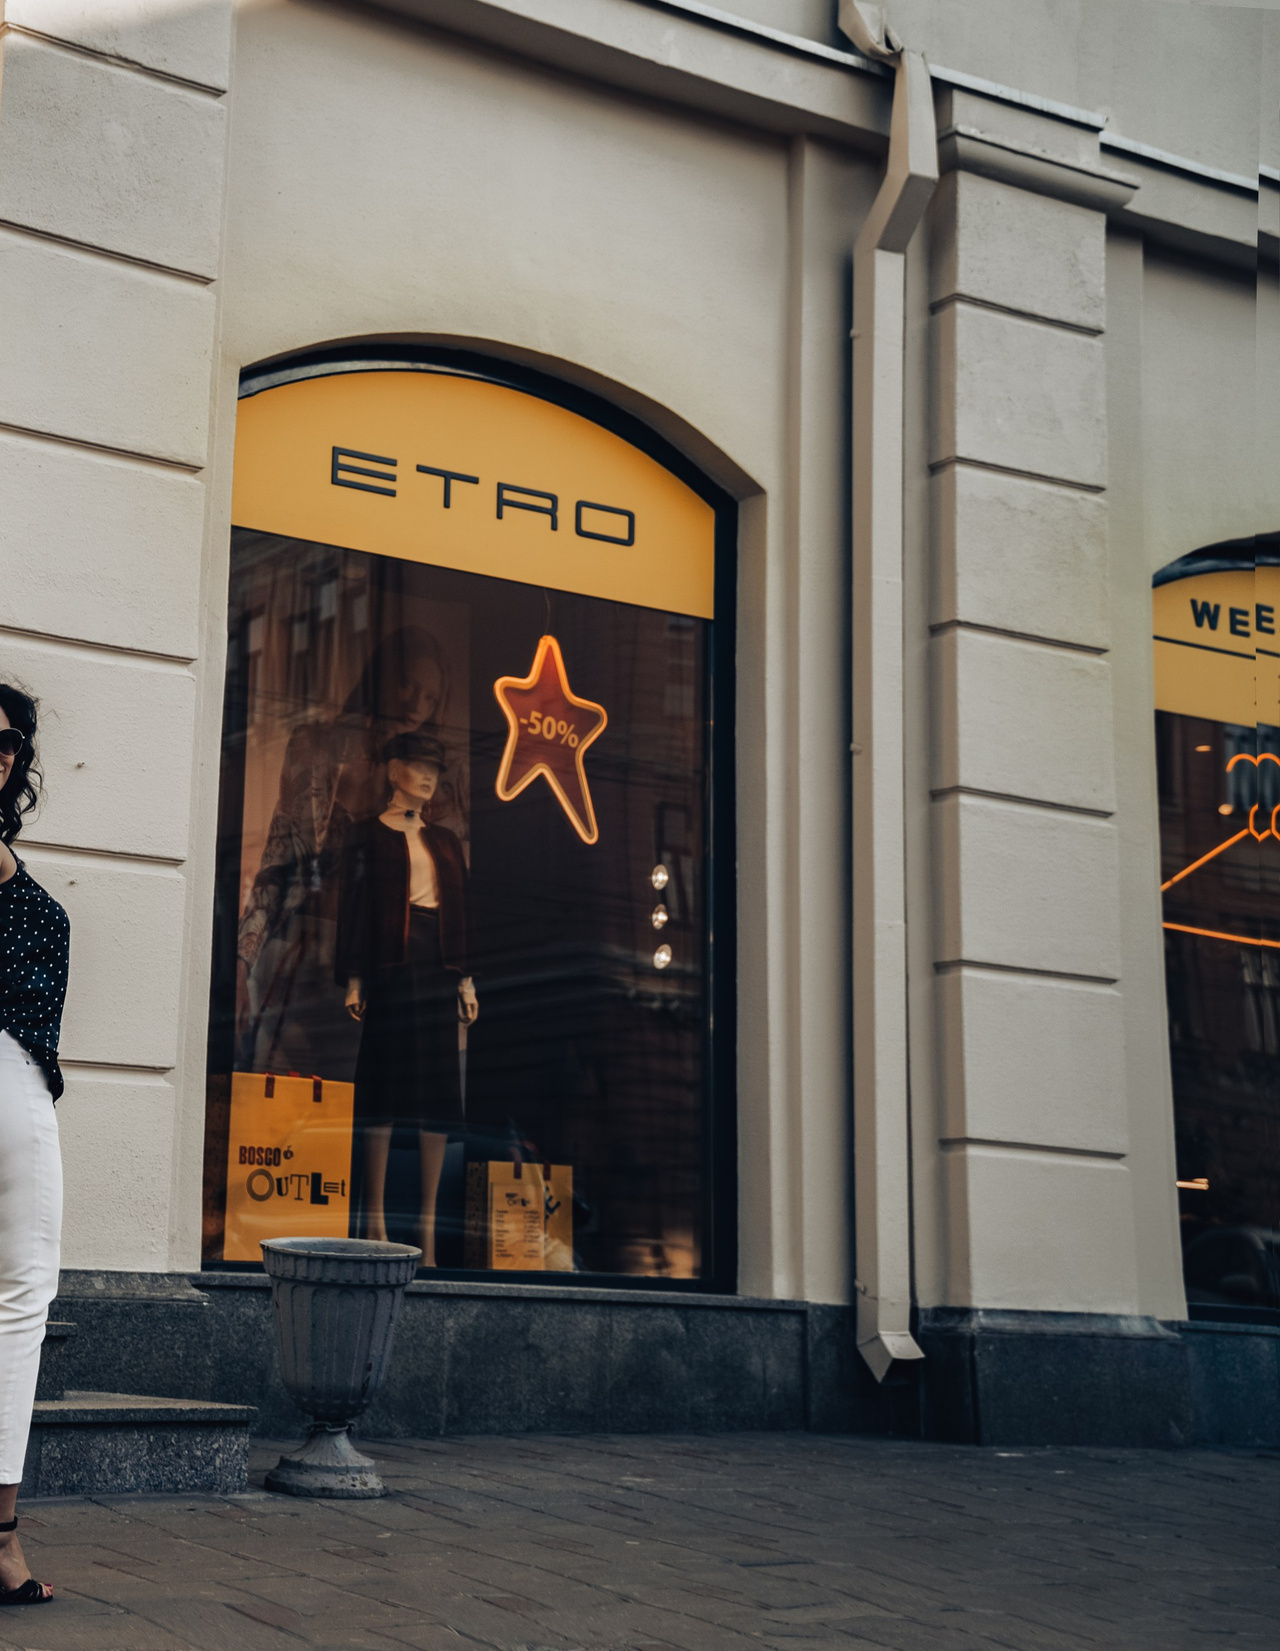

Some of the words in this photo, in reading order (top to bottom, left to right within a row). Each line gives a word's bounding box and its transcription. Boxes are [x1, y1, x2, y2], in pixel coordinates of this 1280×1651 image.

[331, 446, 635, 546] ETRO
[520, 710, 579, 748] -50%
[238, 1145, 281, 1167] BOSCO
